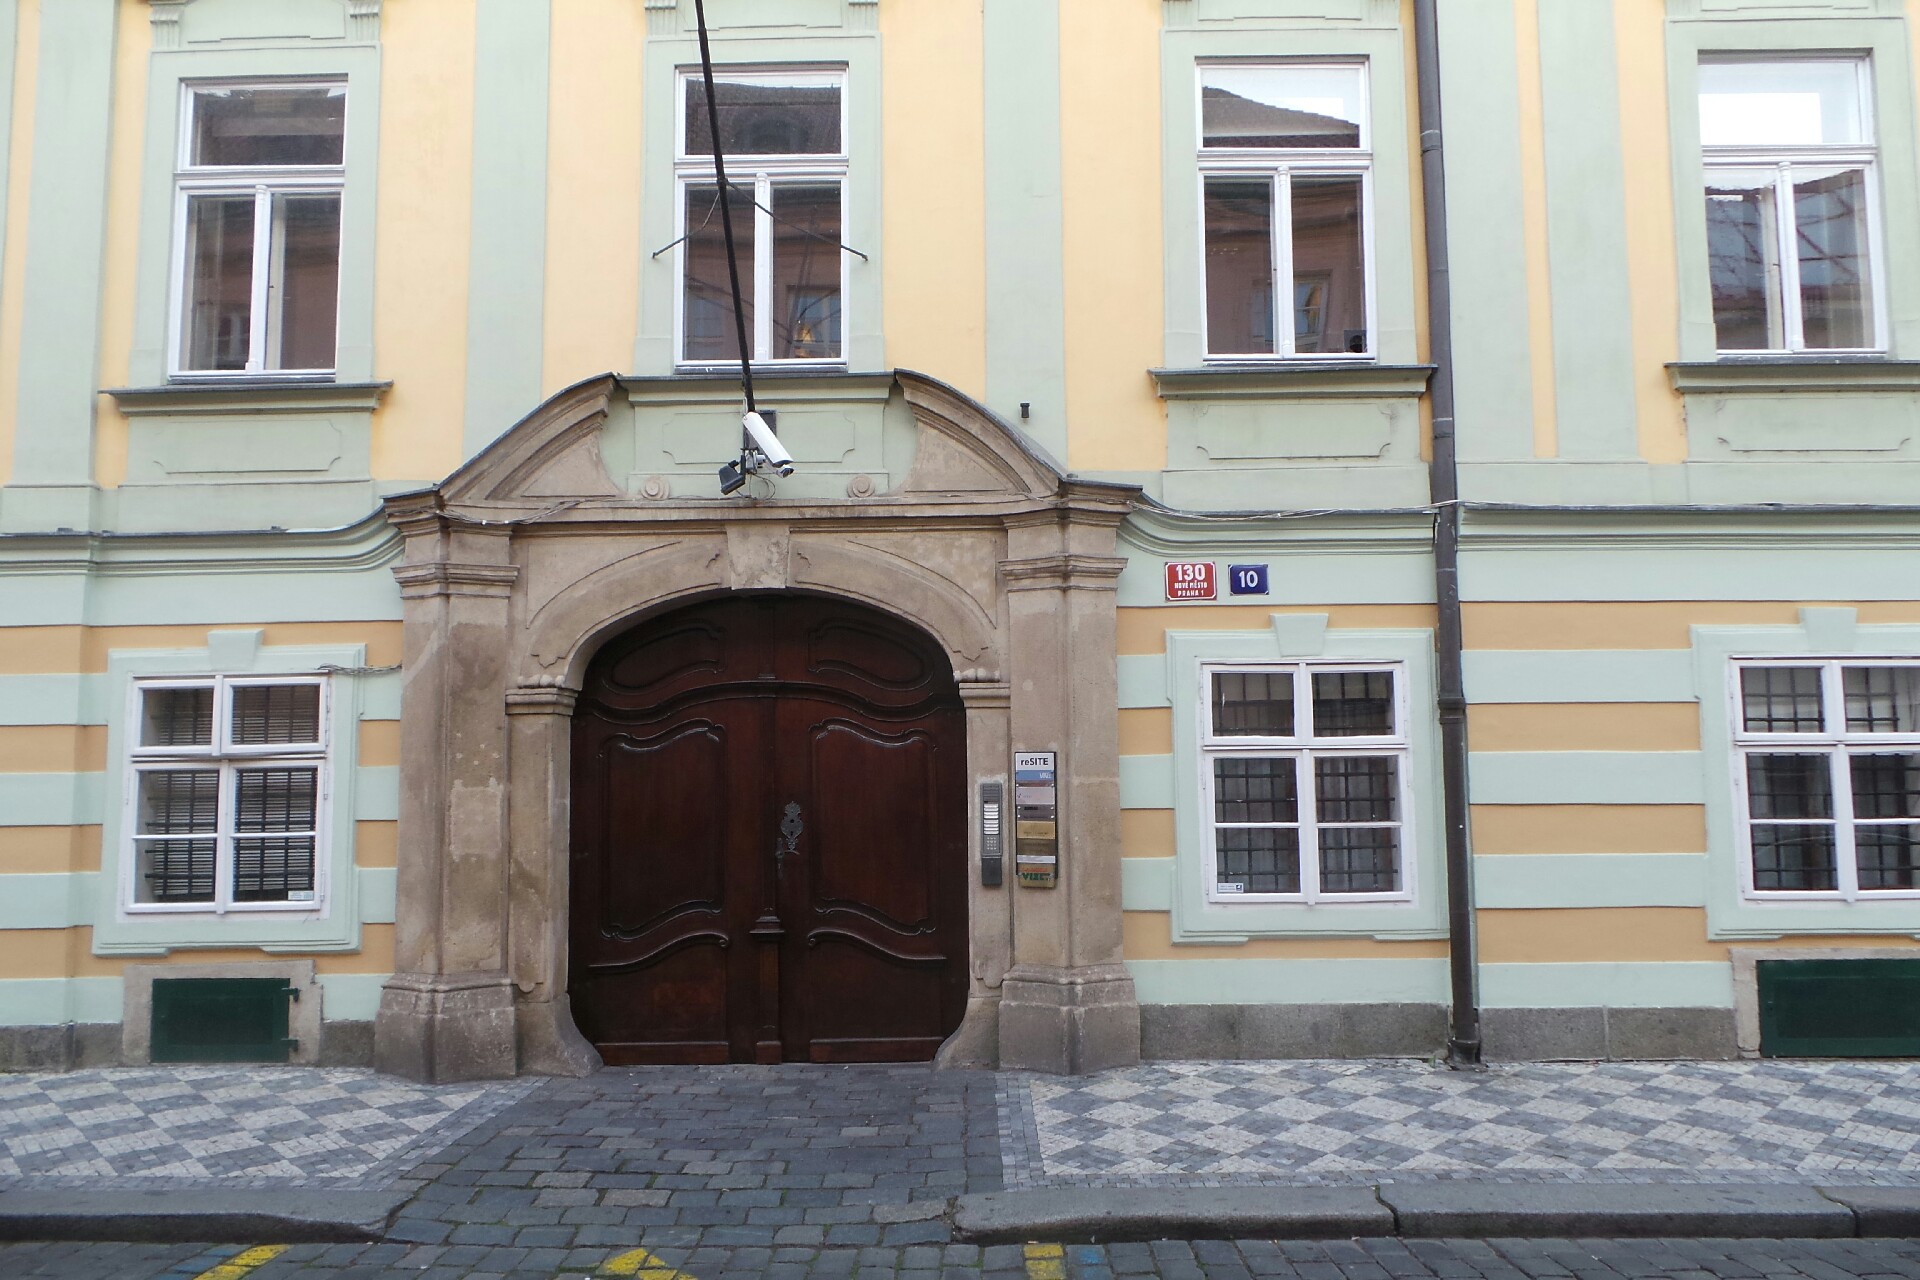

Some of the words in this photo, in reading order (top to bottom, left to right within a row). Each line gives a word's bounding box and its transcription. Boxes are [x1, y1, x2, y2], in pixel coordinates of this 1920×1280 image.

[1176, 564, 1206, 581] 130
[1239, 570, 1258, 588] 10
[1174, 581, 1189, 589] NOVÉ
[1189, 580, 1208, 589] MĚSTO
[1020, 757, 1049, 766] reSITE
